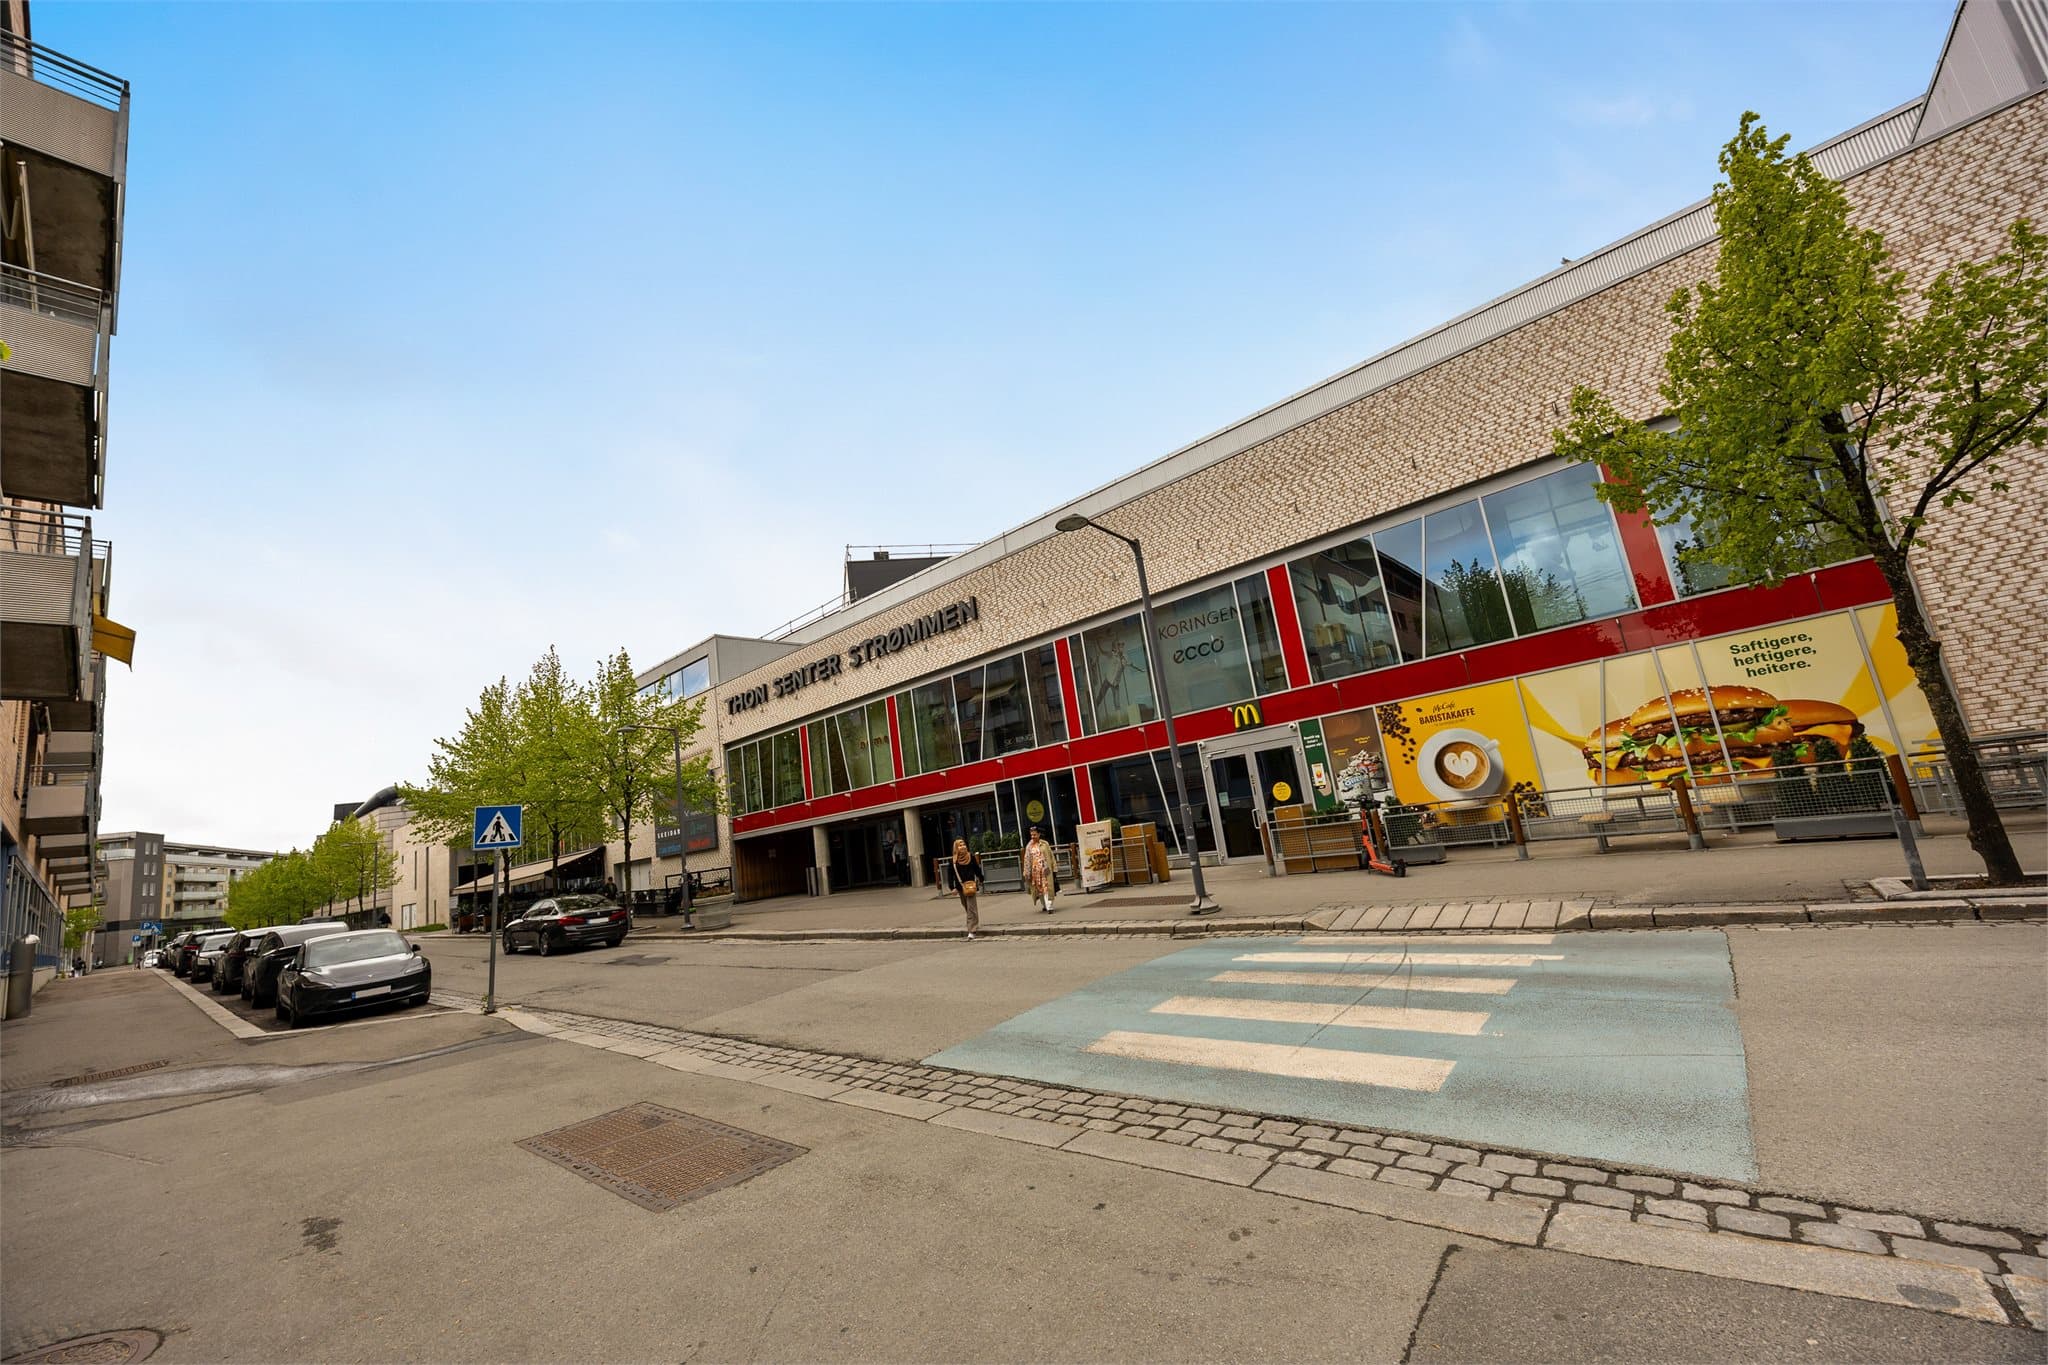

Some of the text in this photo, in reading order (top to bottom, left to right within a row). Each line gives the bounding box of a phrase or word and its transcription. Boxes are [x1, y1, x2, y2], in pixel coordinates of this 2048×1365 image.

[1158, 605, 1238, 640] KORINGEN
[1173, 638, 1224, 664] ecco
[1729, 633, 1813, 655] Saftigere,
[727, 596, 978, 715] THON SENTER STRØMMEN
[1733, 646, 1816, 667] heftigere,
[1746, 660, 1811, 678] heitere.
[1419, 707, 1476, 725] BARISTAKAFFE
